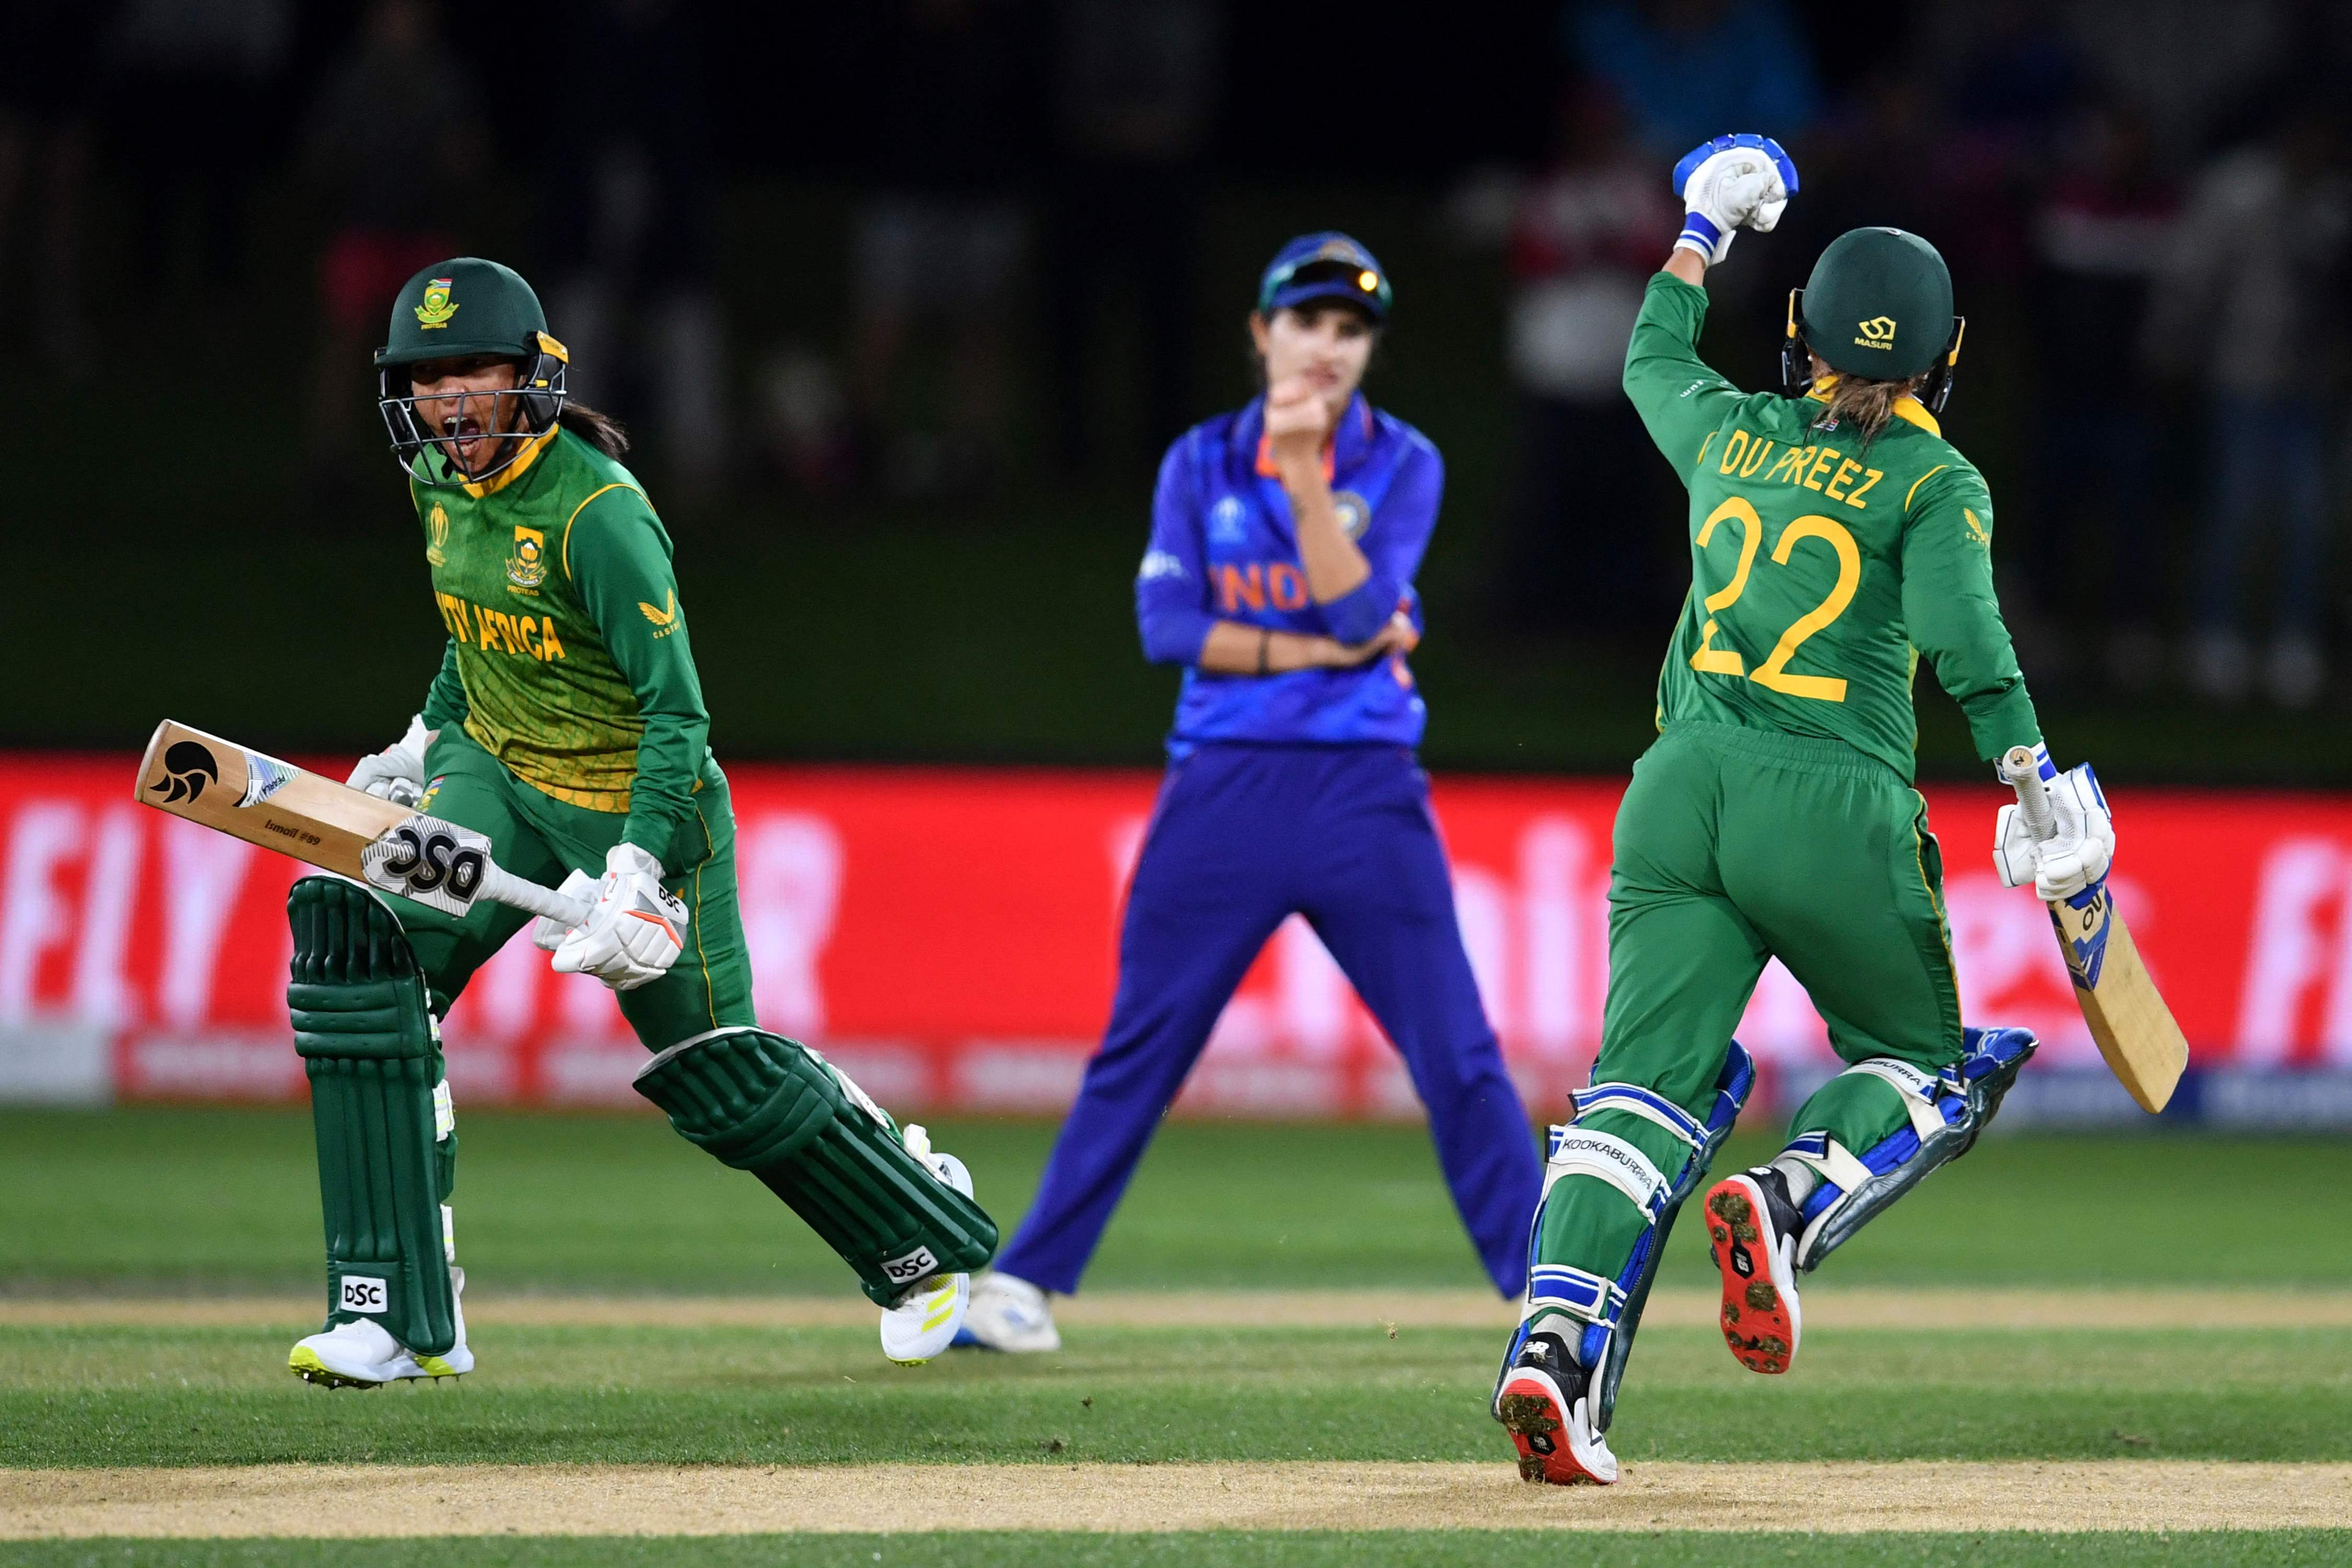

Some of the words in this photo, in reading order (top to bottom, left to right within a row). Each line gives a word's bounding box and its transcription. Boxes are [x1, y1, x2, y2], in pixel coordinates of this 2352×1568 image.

[1854, 337, 1893, 351] MASURI
[1720, 429, 1774, 478] DU
[1763, 445, 1884, 510] PREEZ
[507, 585, 539, 596] PROTEAS
[1207, 561, 1308, 613] IND
[1689, 496, 1861, 702] 22
[474, 604, 566, 662] AFRICA
[262, 774, 286, 795] PEARLA
[264, 819, 299, 838] Ismail
[298, 832, 321, 845] #89
[384, 826, 487, 902] DSC
[659, 886, 680, 914] DSC
[1562, 1138, 1653, 1191] KOOKABURRA
[887, 1252, 931, 1278] DSC
[345, 1283, 382, 1306] DSC
